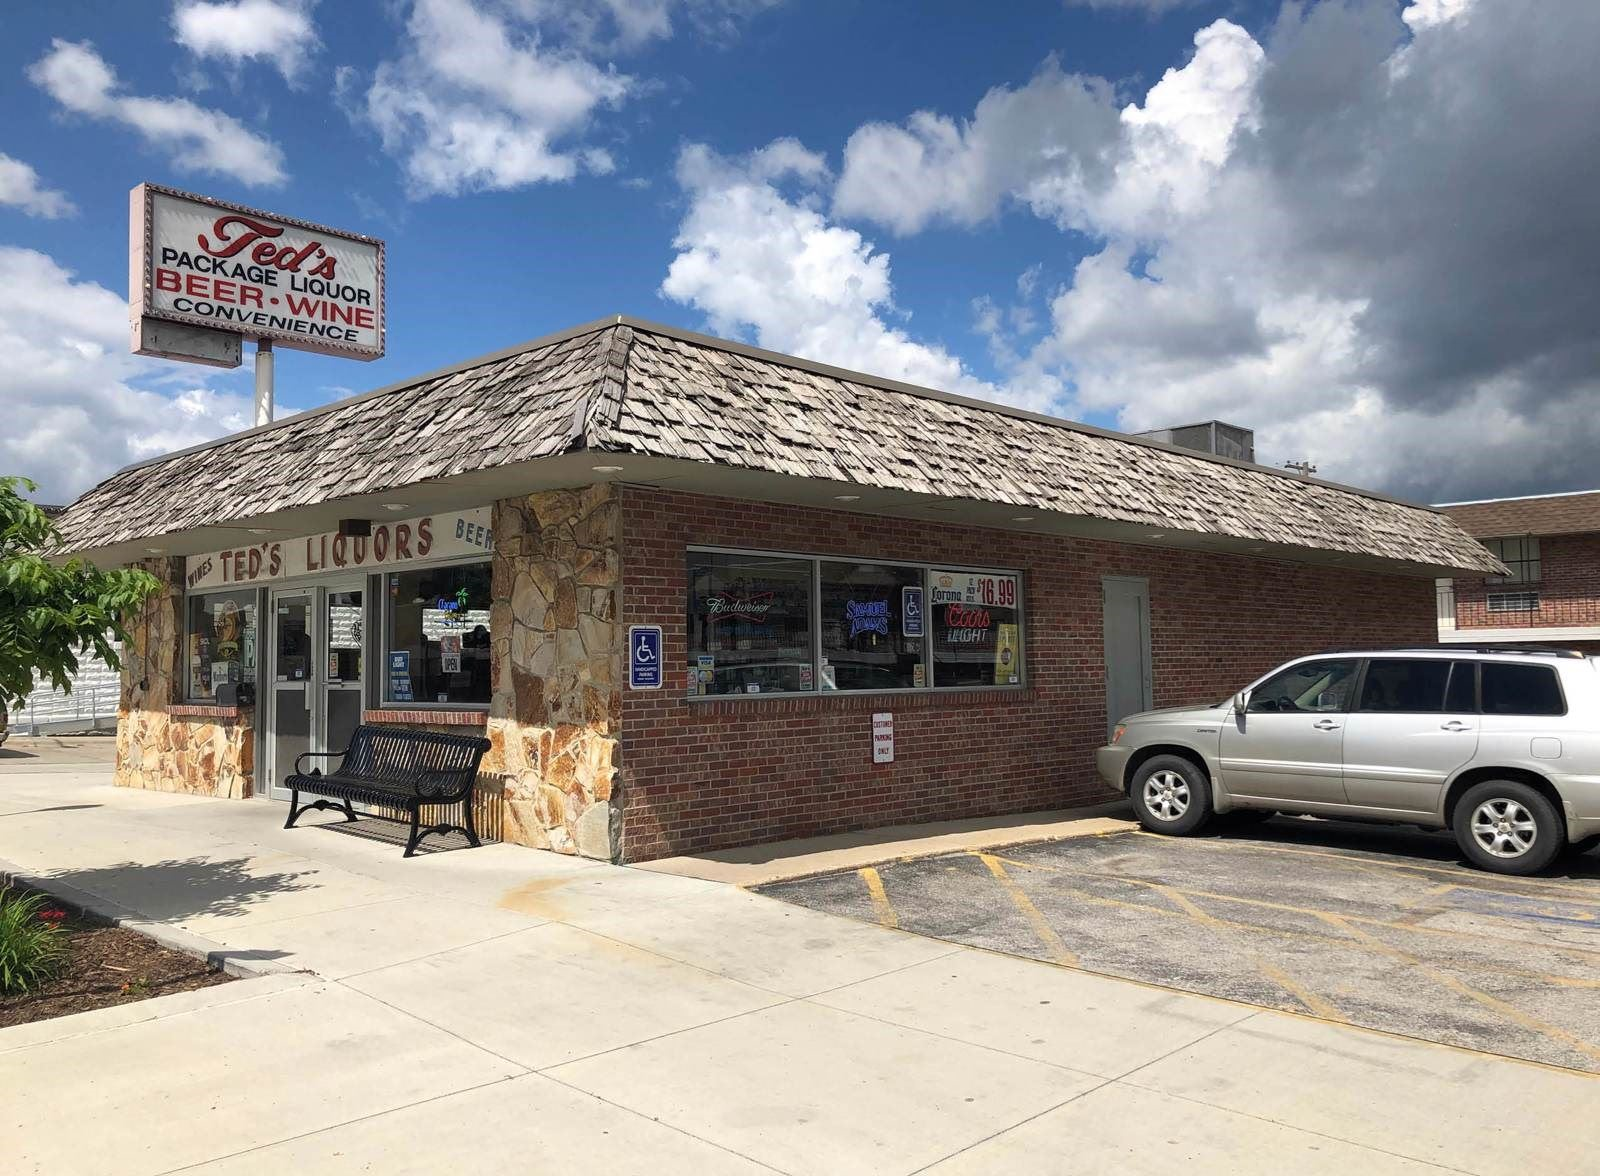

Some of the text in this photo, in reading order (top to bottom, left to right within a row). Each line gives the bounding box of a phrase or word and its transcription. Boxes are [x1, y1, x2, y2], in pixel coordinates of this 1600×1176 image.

[198, 215, 337, 281] Ted's
[162, 247, 371, 306] PACKAGE LIQUOR
[156, 268, 375, 330] BEER WINE
[173, 298, 359, 342] CONVENIENCE
[220, 518, 433, 582] TED'S LIQUORS
[188, 557, 213, 588] WINES
[931, 586, 962, 604] Corona
[977, 578, 1014, 606] $16.99
[707, 598, 769, 613] Budweiser
[847, 600, 889, 620] SAMUEL
[946, 603, 990, 627] Coors
[850, 617, 888, 638] ADAMS
[947, 628, 988, 643] LIGHT
[444, 657, 458, 671] OPEN
[874, 733, 892, 741] PARKING
[878, 747, 888, 755] ONLY
